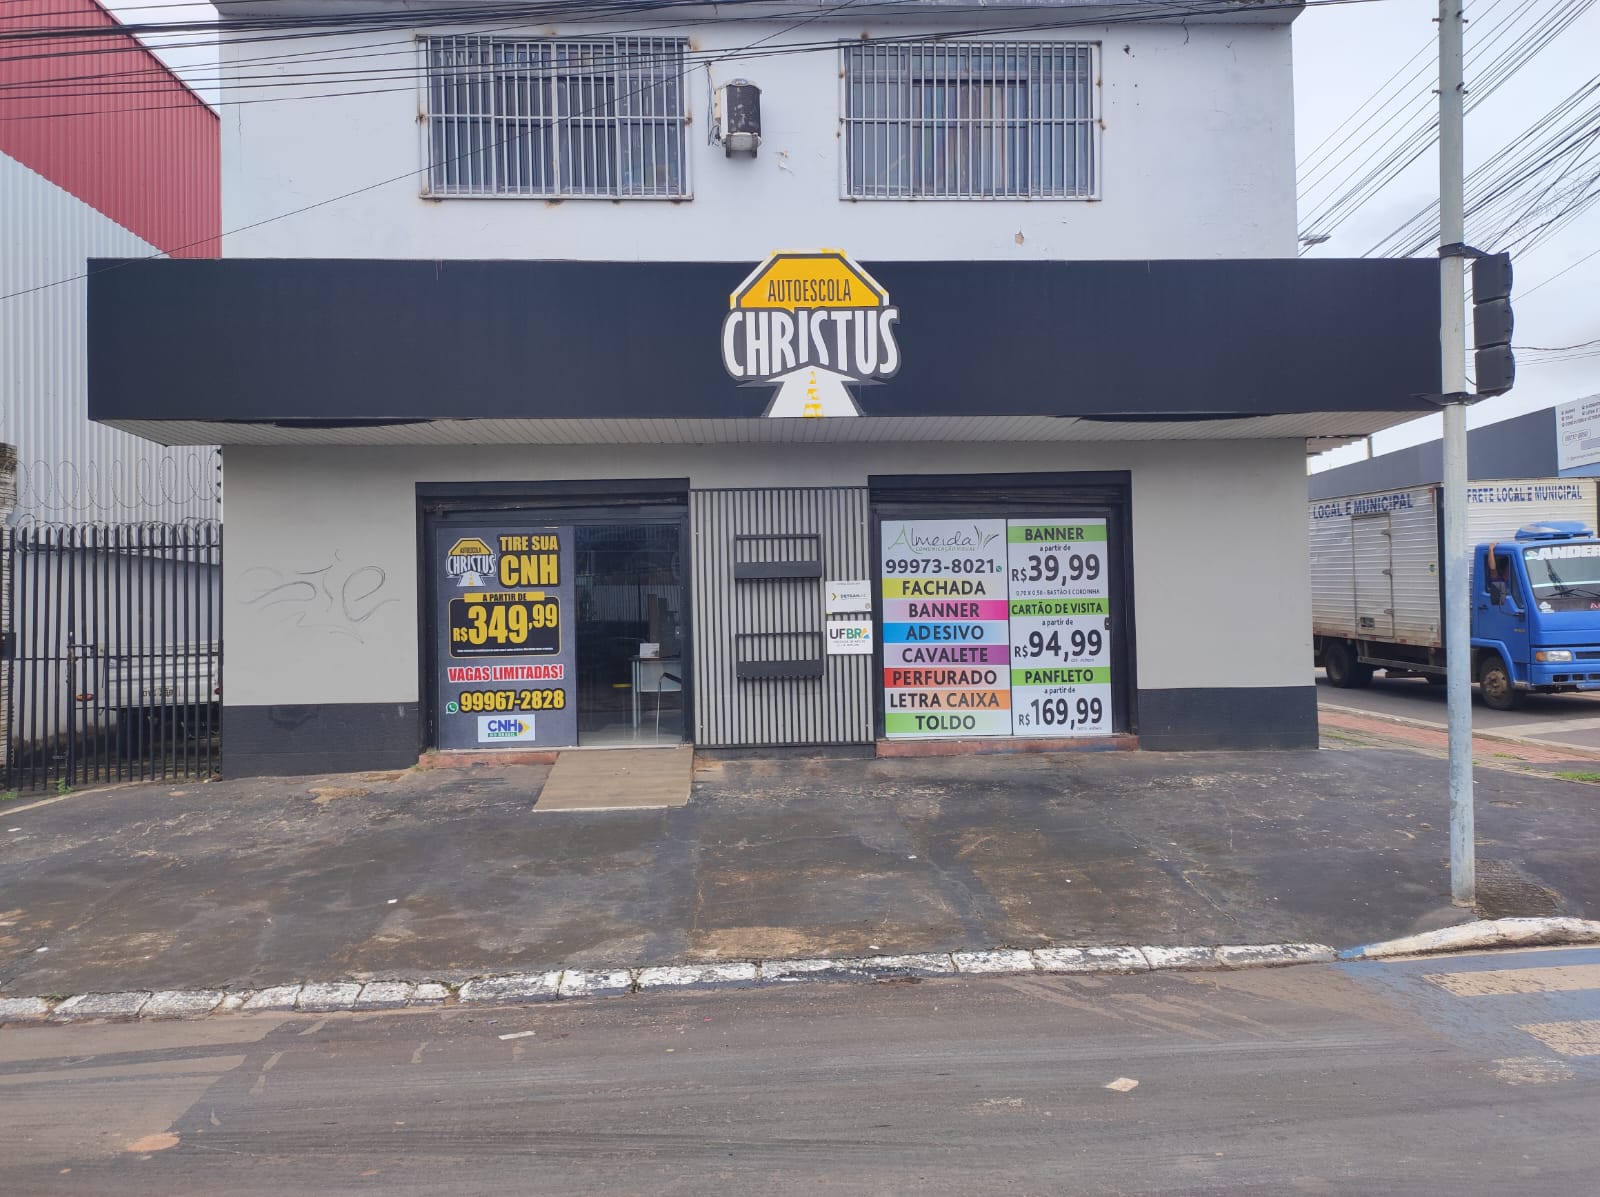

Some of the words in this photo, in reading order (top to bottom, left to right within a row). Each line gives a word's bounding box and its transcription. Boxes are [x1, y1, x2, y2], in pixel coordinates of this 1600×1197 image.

[767, 278, 851, 303] AUTOESCOLA
[722, 308, 900, 377] CHRISTUS
[1467, 488, 1493, 503] FRETE
[1497, 487, 1525, 502] LOCAL
[1535, 485, 1582, 501] MUNICIPAL
[1313, 503, 1342, 519] LOCAL
[1354, 493, 1413, 514] MUNICIPAL
[888, 524, 976, 554] Almeida
[1025, 527, 1084, 541] BANNER
[500, 536, 528, 551] TIRE
[531, 535, 558, 551] SUA
[1045, 544, 1061, 553] partir
[447, 554, 496, 575] CHRISTUS
[500, 554, 558, 586] CNH
[885, 558, 995, 574] 99973-8021
[902, 580, 986, 596] FACHADA
[483, 594, 487, 602] A
[489, 593, 516, 601] PARTIR
[518, 593, 527, 601] DE
[908, 602, 980, 618] BANNER
[1012, 602, 1053, 615] CARTÃO
[1055, 603, 1068, 614] DE
[1071, 602, 1103, 613] VISITA
[1047, 618, 1063, 627] partir
[906, 625, 984, 640] ADESIVO
[902, 647, 988, 663] CAVALETE
[448, 667, 490, 682] VAGAS
[493, 665, 563, 680] LIMITADAS!
[893, 670, 997, 685] PERFURADO
[1025, 669, 1094, 683] PANFLETO
[1049, 687, 1066, 695] partir
[460, 690, 565, 712] 99967-2828
[890, 693, 941, 708] LETRA
[946, 692, 999, 707] CAIXA
[488, 719, 517, 732] CNH
[915, 715, 976, 730] TOLDO
